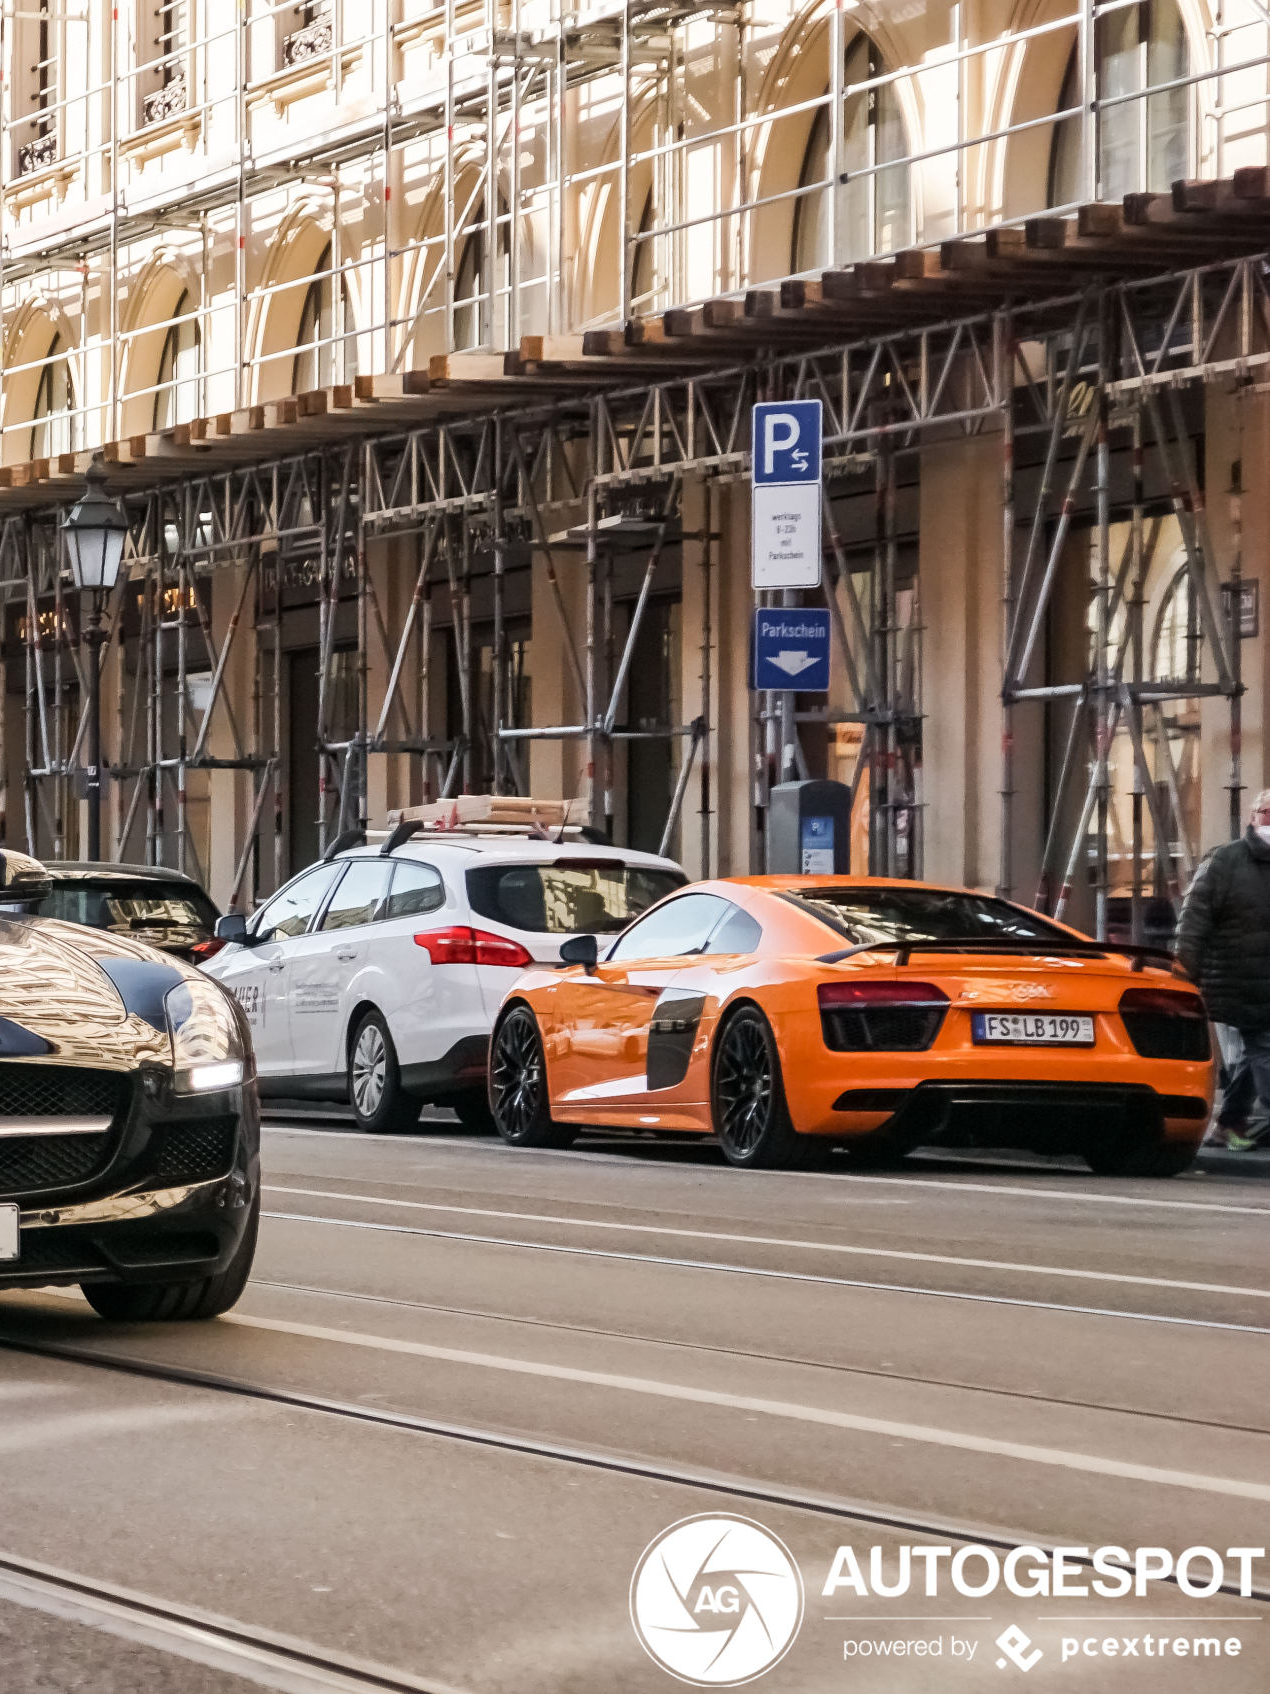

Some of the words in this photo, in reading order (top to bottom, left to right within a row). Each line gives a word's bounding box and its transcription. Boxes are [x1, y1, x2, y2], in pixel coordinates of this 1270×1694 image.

[764, 413, 801, 475] P
[762, 622, 826, 638] Parkschein
[988, 1016, 1010, 1036] FS
[1023, 1018, 1045, 1038] LB
[1049, 1019, 1079, 1039] 199
